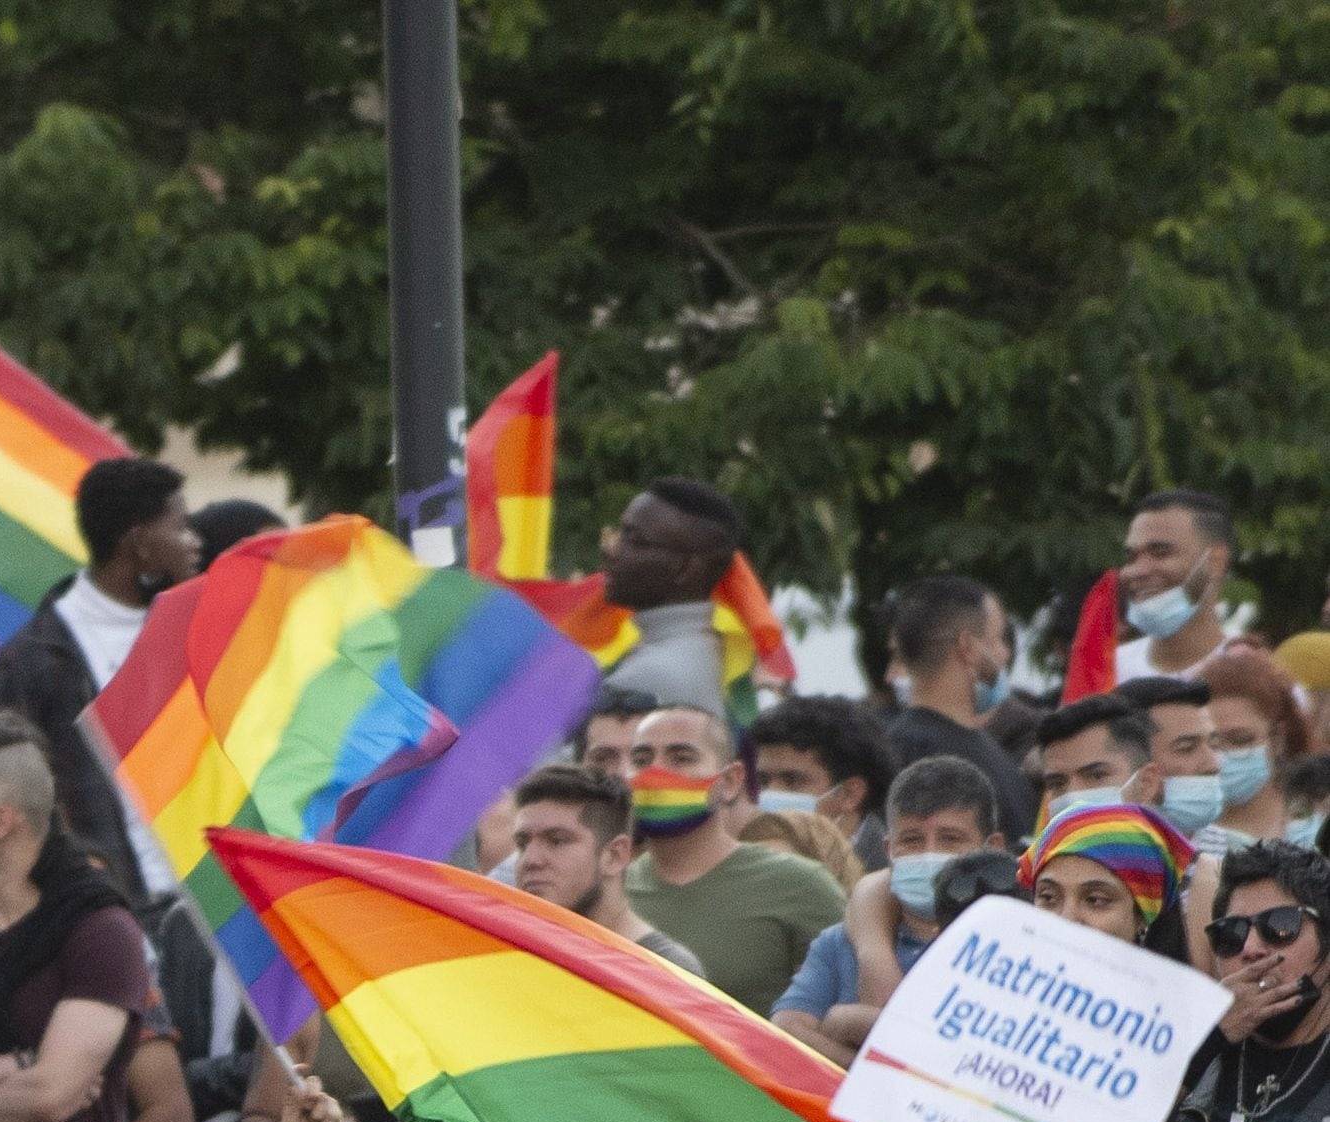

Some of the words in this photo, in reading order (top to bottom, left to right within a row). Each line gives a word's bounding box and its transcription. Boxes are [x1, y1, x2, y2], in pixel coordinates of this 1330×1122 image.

[933, 987, 1138, 1099] Igualitario
[952, 932, 1175, 1055] Matrimonio
[954, 1050, 1063, 1111] ¡AHORA!
